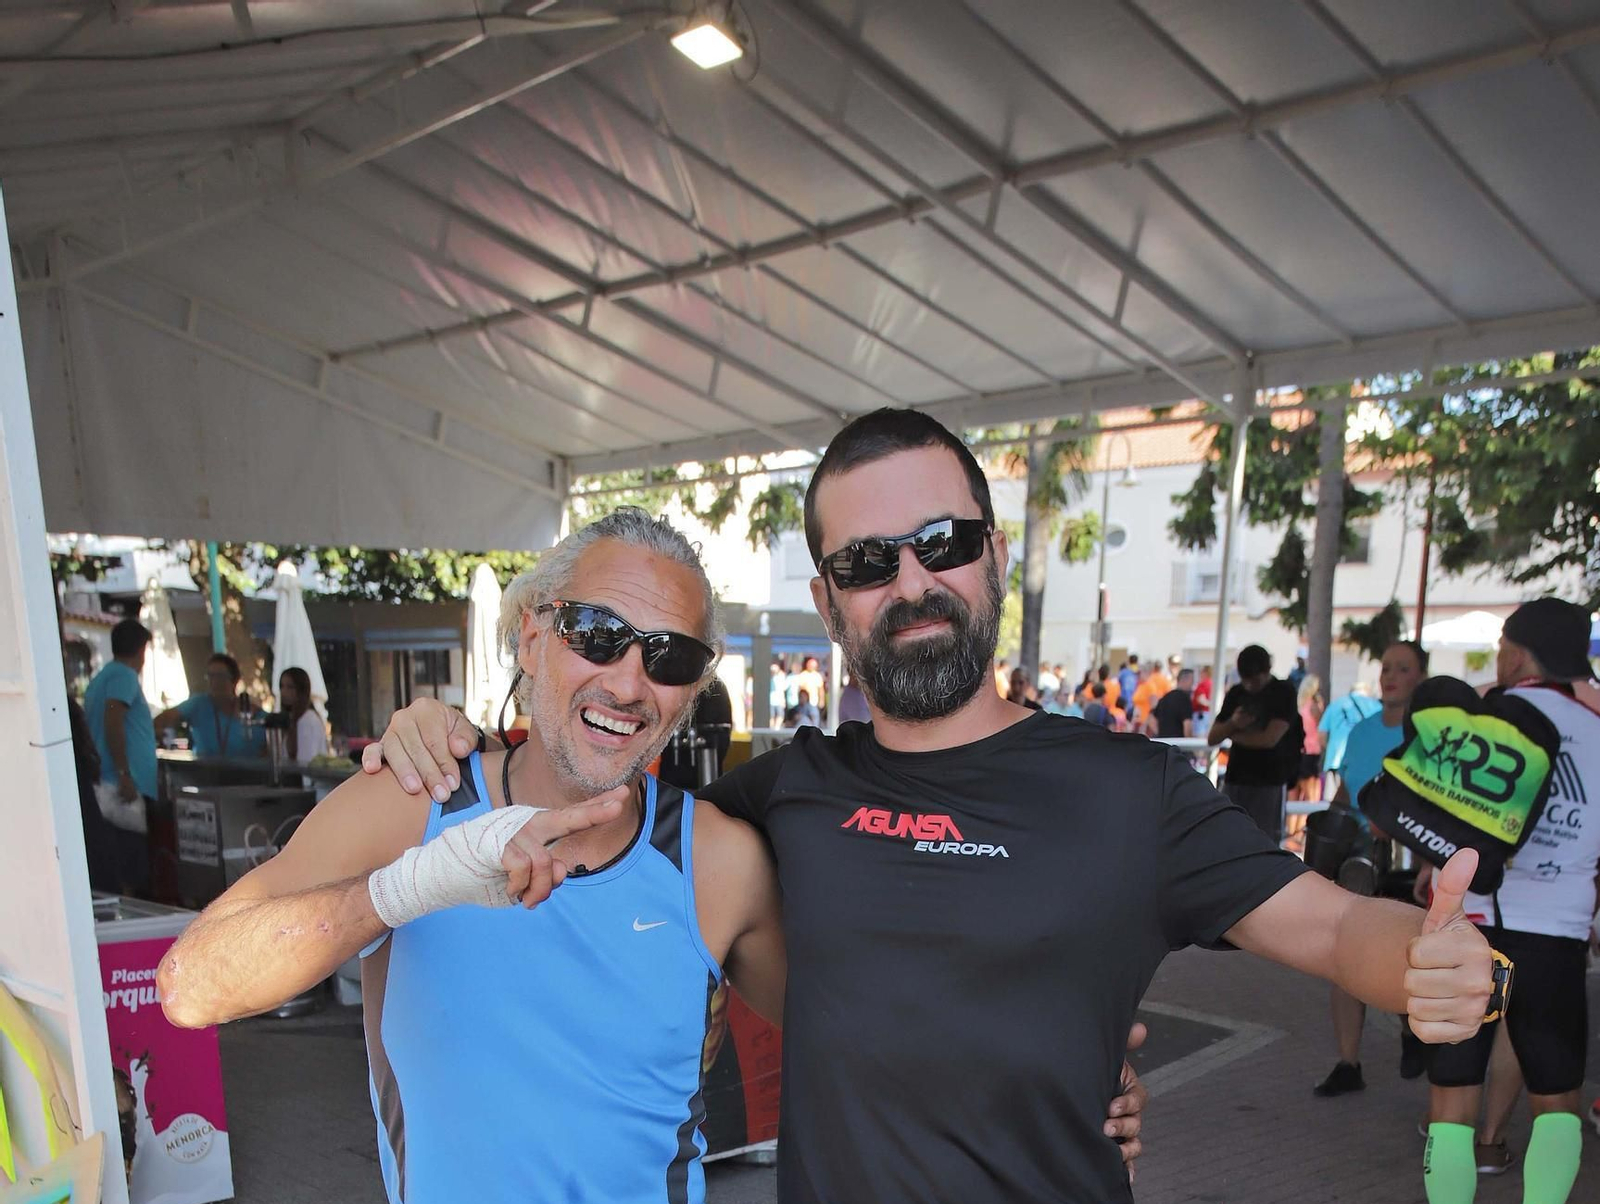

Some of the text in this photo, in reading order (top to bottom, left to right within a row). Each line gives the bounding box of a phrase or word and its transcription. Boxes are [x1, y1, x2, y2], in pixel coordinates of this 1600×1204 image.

[841, 807, 1009, 857] AGUNSA EUROPA
[166, 1124, 213, 1152] MENORCA
